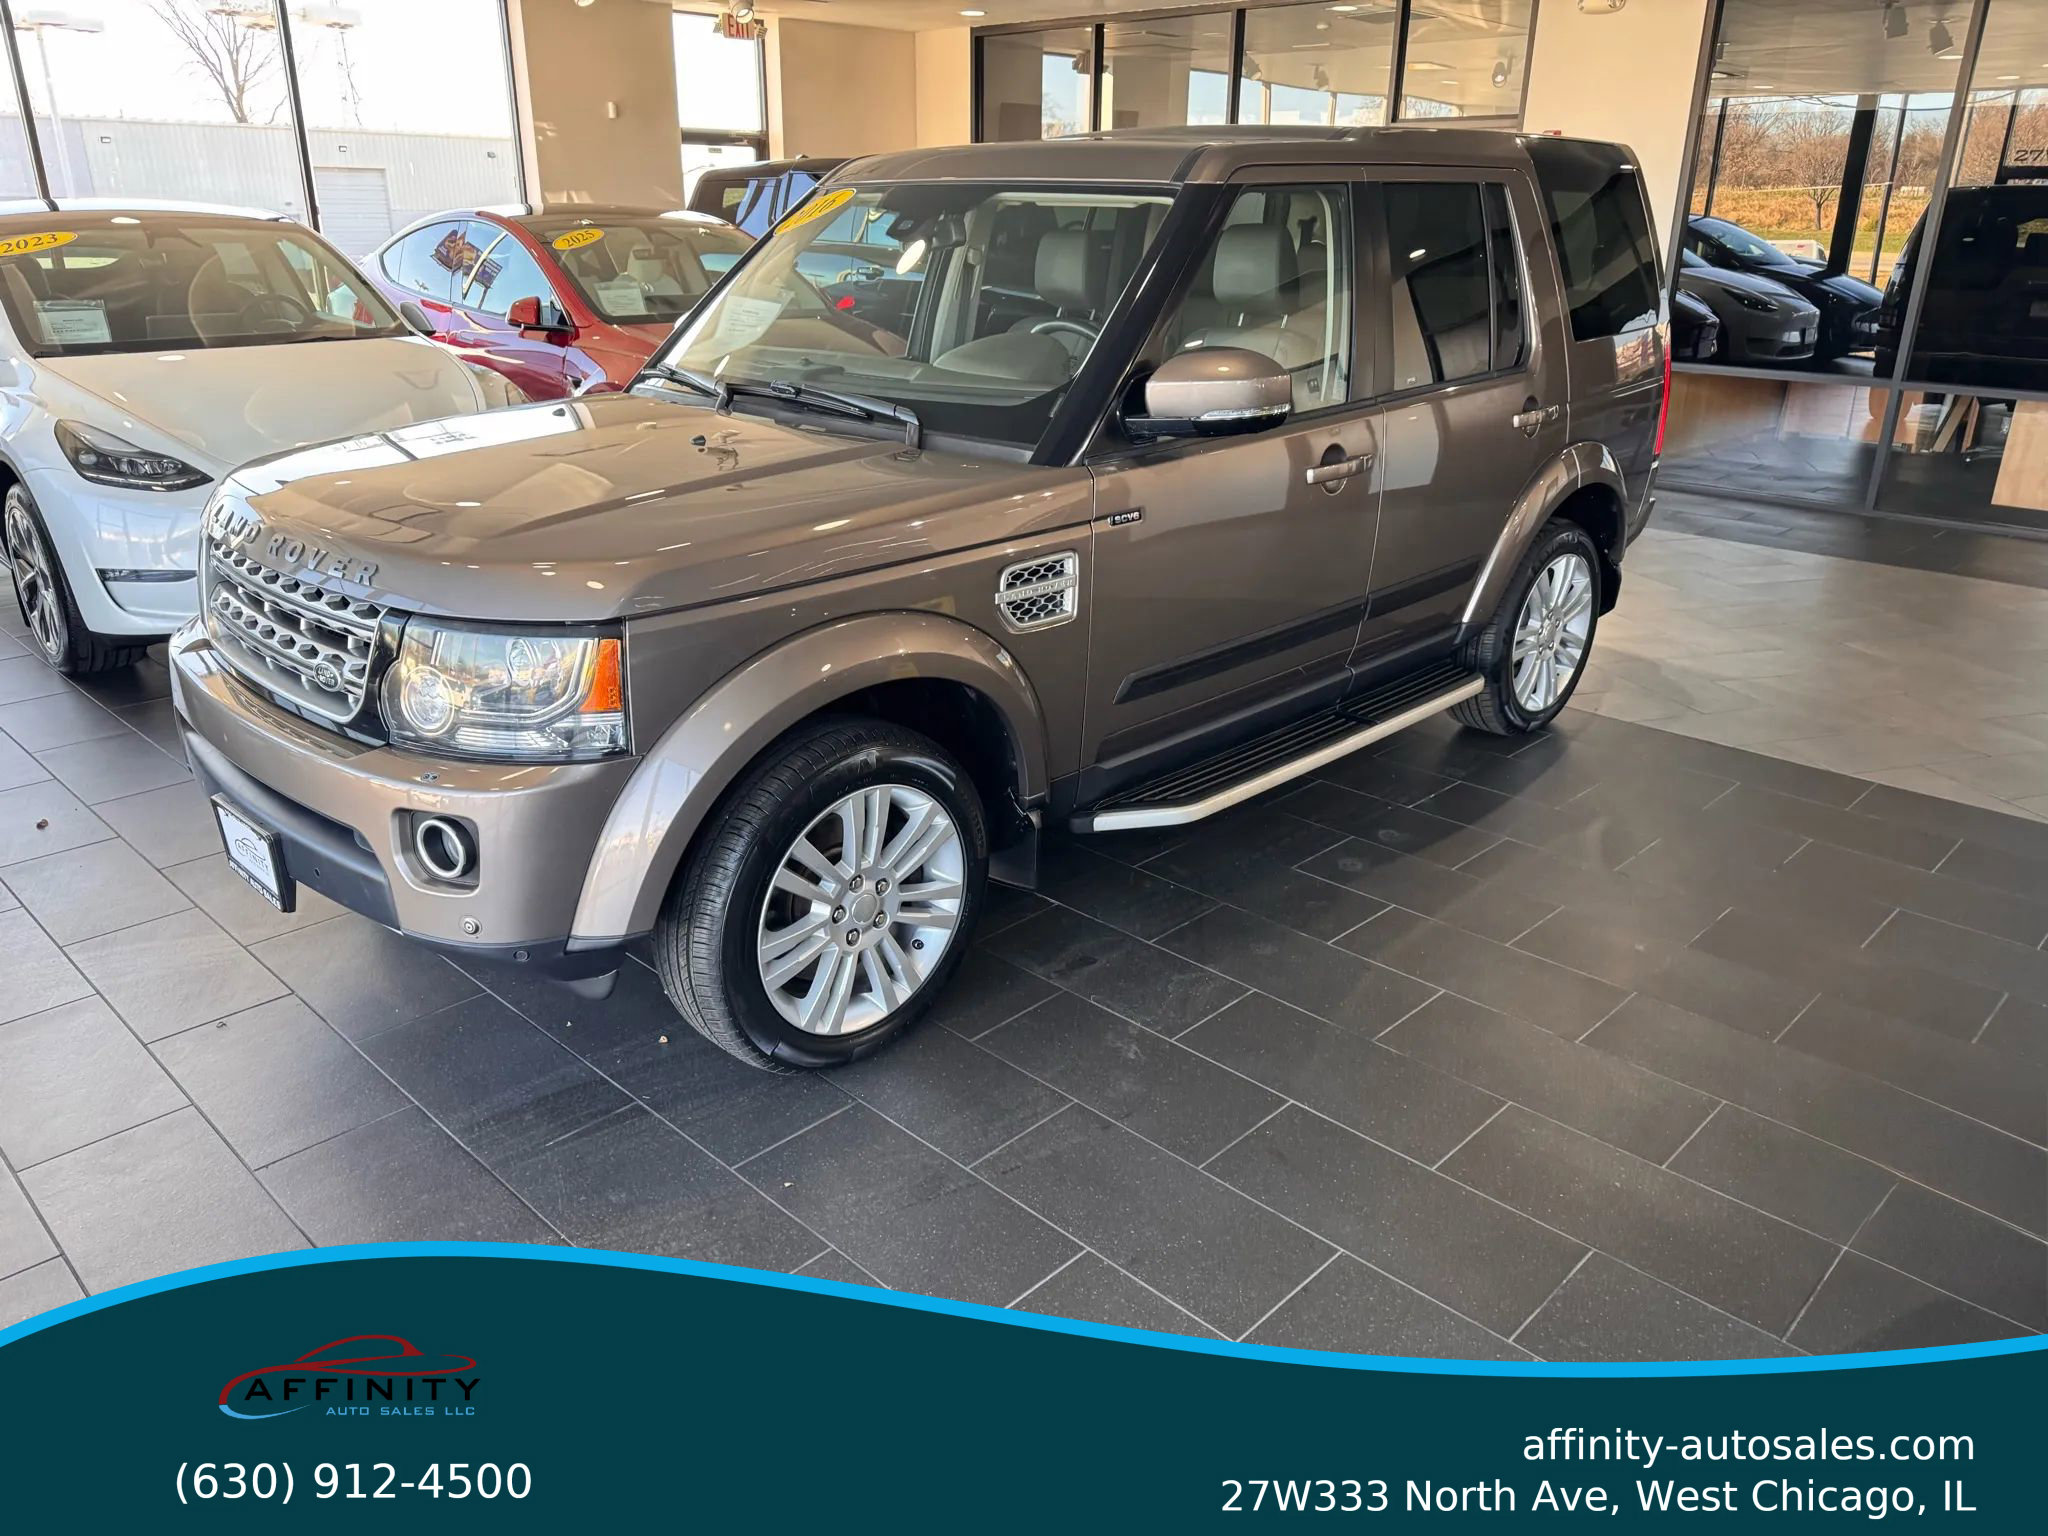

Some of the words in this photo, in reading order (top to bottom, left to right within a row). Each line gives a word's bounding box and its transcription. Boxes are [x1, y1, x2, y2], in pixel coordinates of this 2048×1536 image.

[2013, 149, 2048, 162] 27
[0, 233, 58, 254] 2023
[562, 230, 595, 248] 2025
[1114, 511, 1140, 524] SCV6
[208, 503, 261, 546] LAND
[267, 533, 378, 586] ROVER
